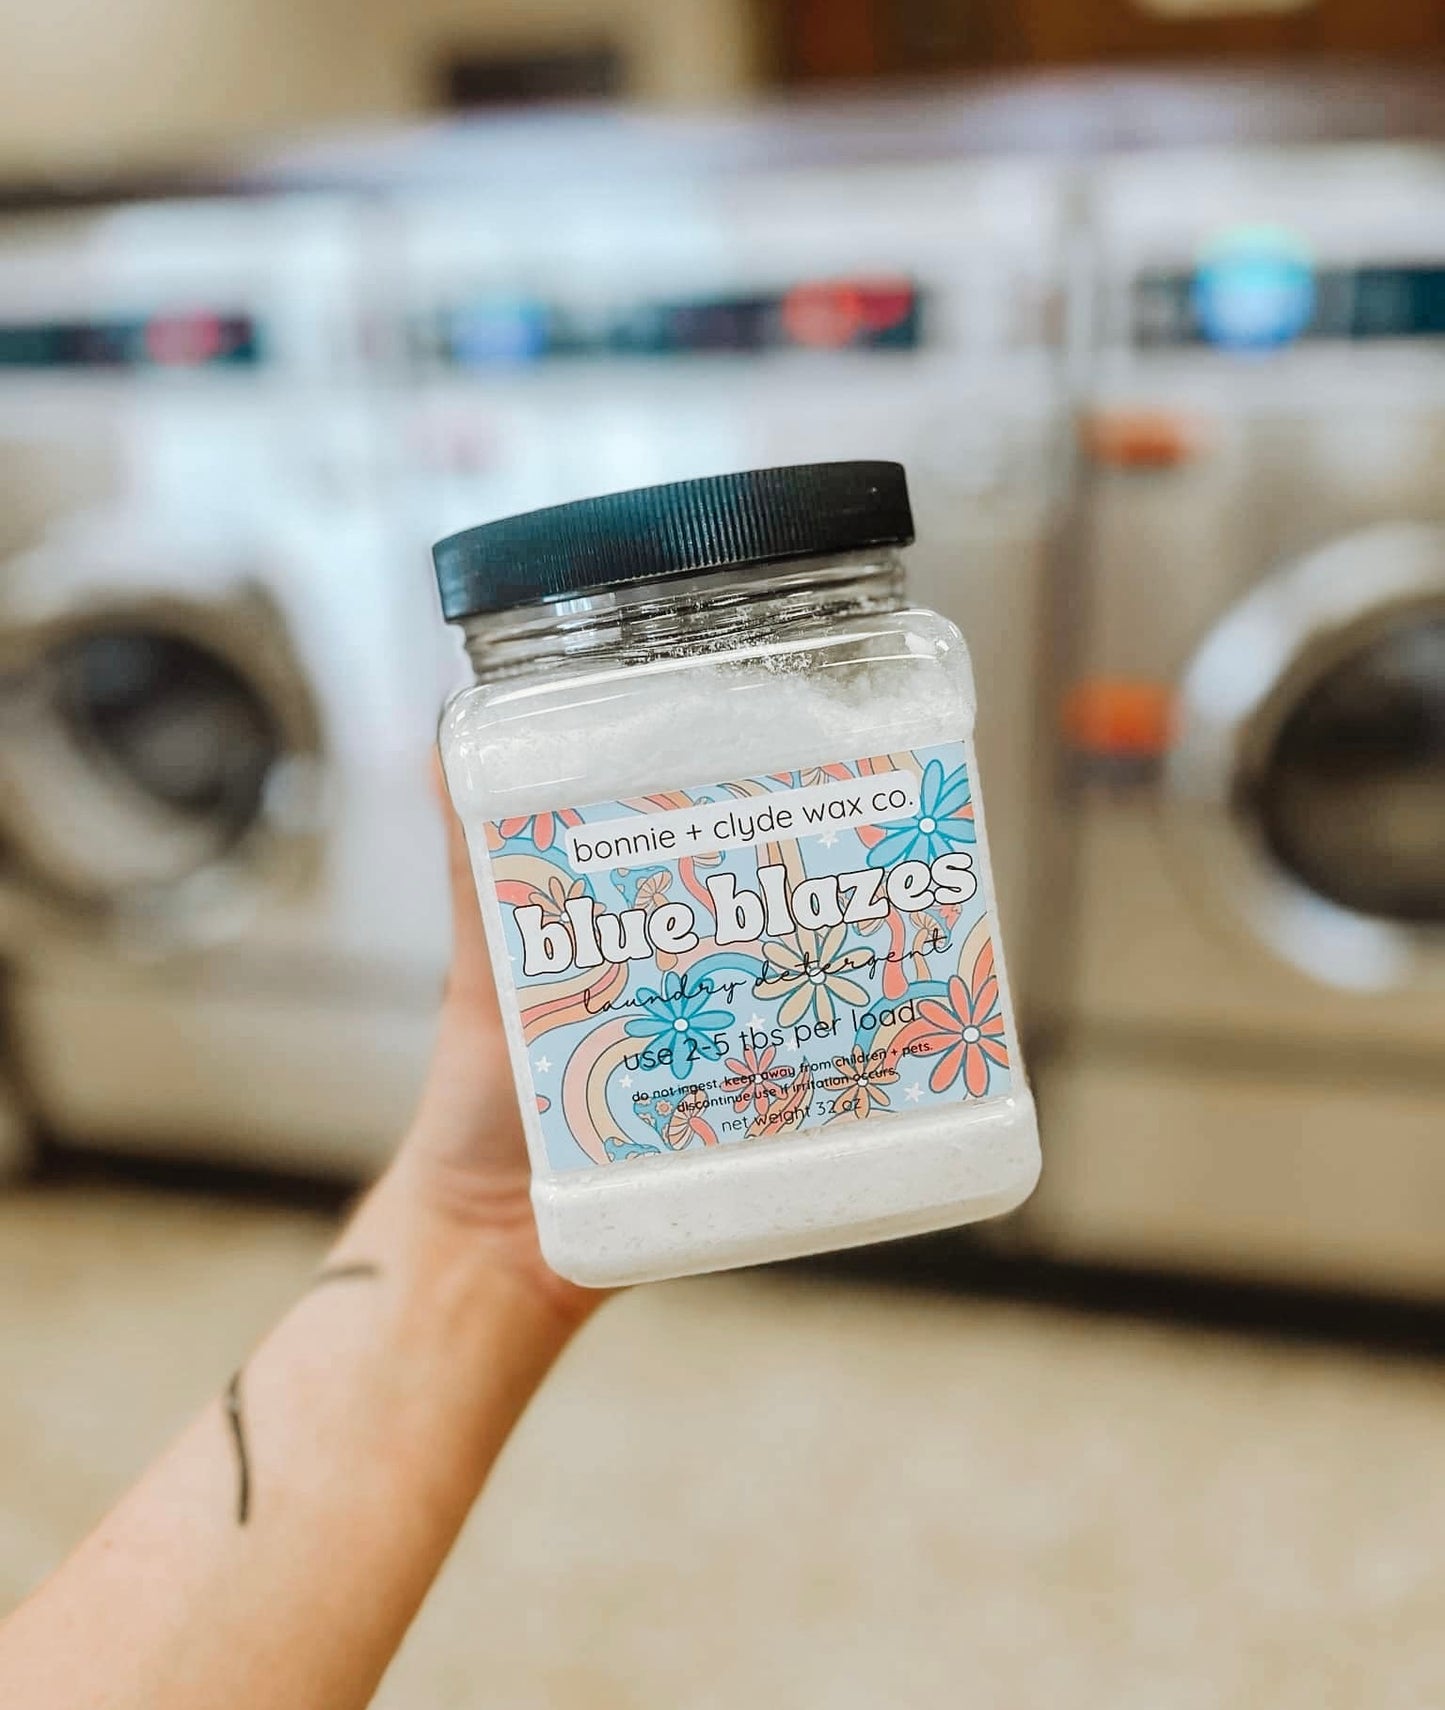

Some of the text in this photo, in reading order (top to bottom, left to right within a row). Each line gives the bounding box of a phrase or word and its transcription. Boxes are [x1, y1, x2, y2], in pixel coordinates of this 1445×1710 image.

[573, 789, 914, 863] bonnie + clyde wax co.
[513, 852, 978, 977] blue blazes
[583, 927, 953, 1015] laundry detergent
[623, 999, 916, 1071] use 2-5 tbs per load
[632, 1090, 649, 1102] do
[653, 1088, 673, 1099] not
[724, 1074, 756, 1088] keep
[760, 1068, 796, 1084] away
[800, 1058, 831, 1073] from
[835, 1048, 887, 1068] children
[902, 1042, 934, 1057] pets.
[676, 1066, 899, 1113] discontinue use if irritation occurs.
[721, 1097, 863, 1132] net weight 32 oz
